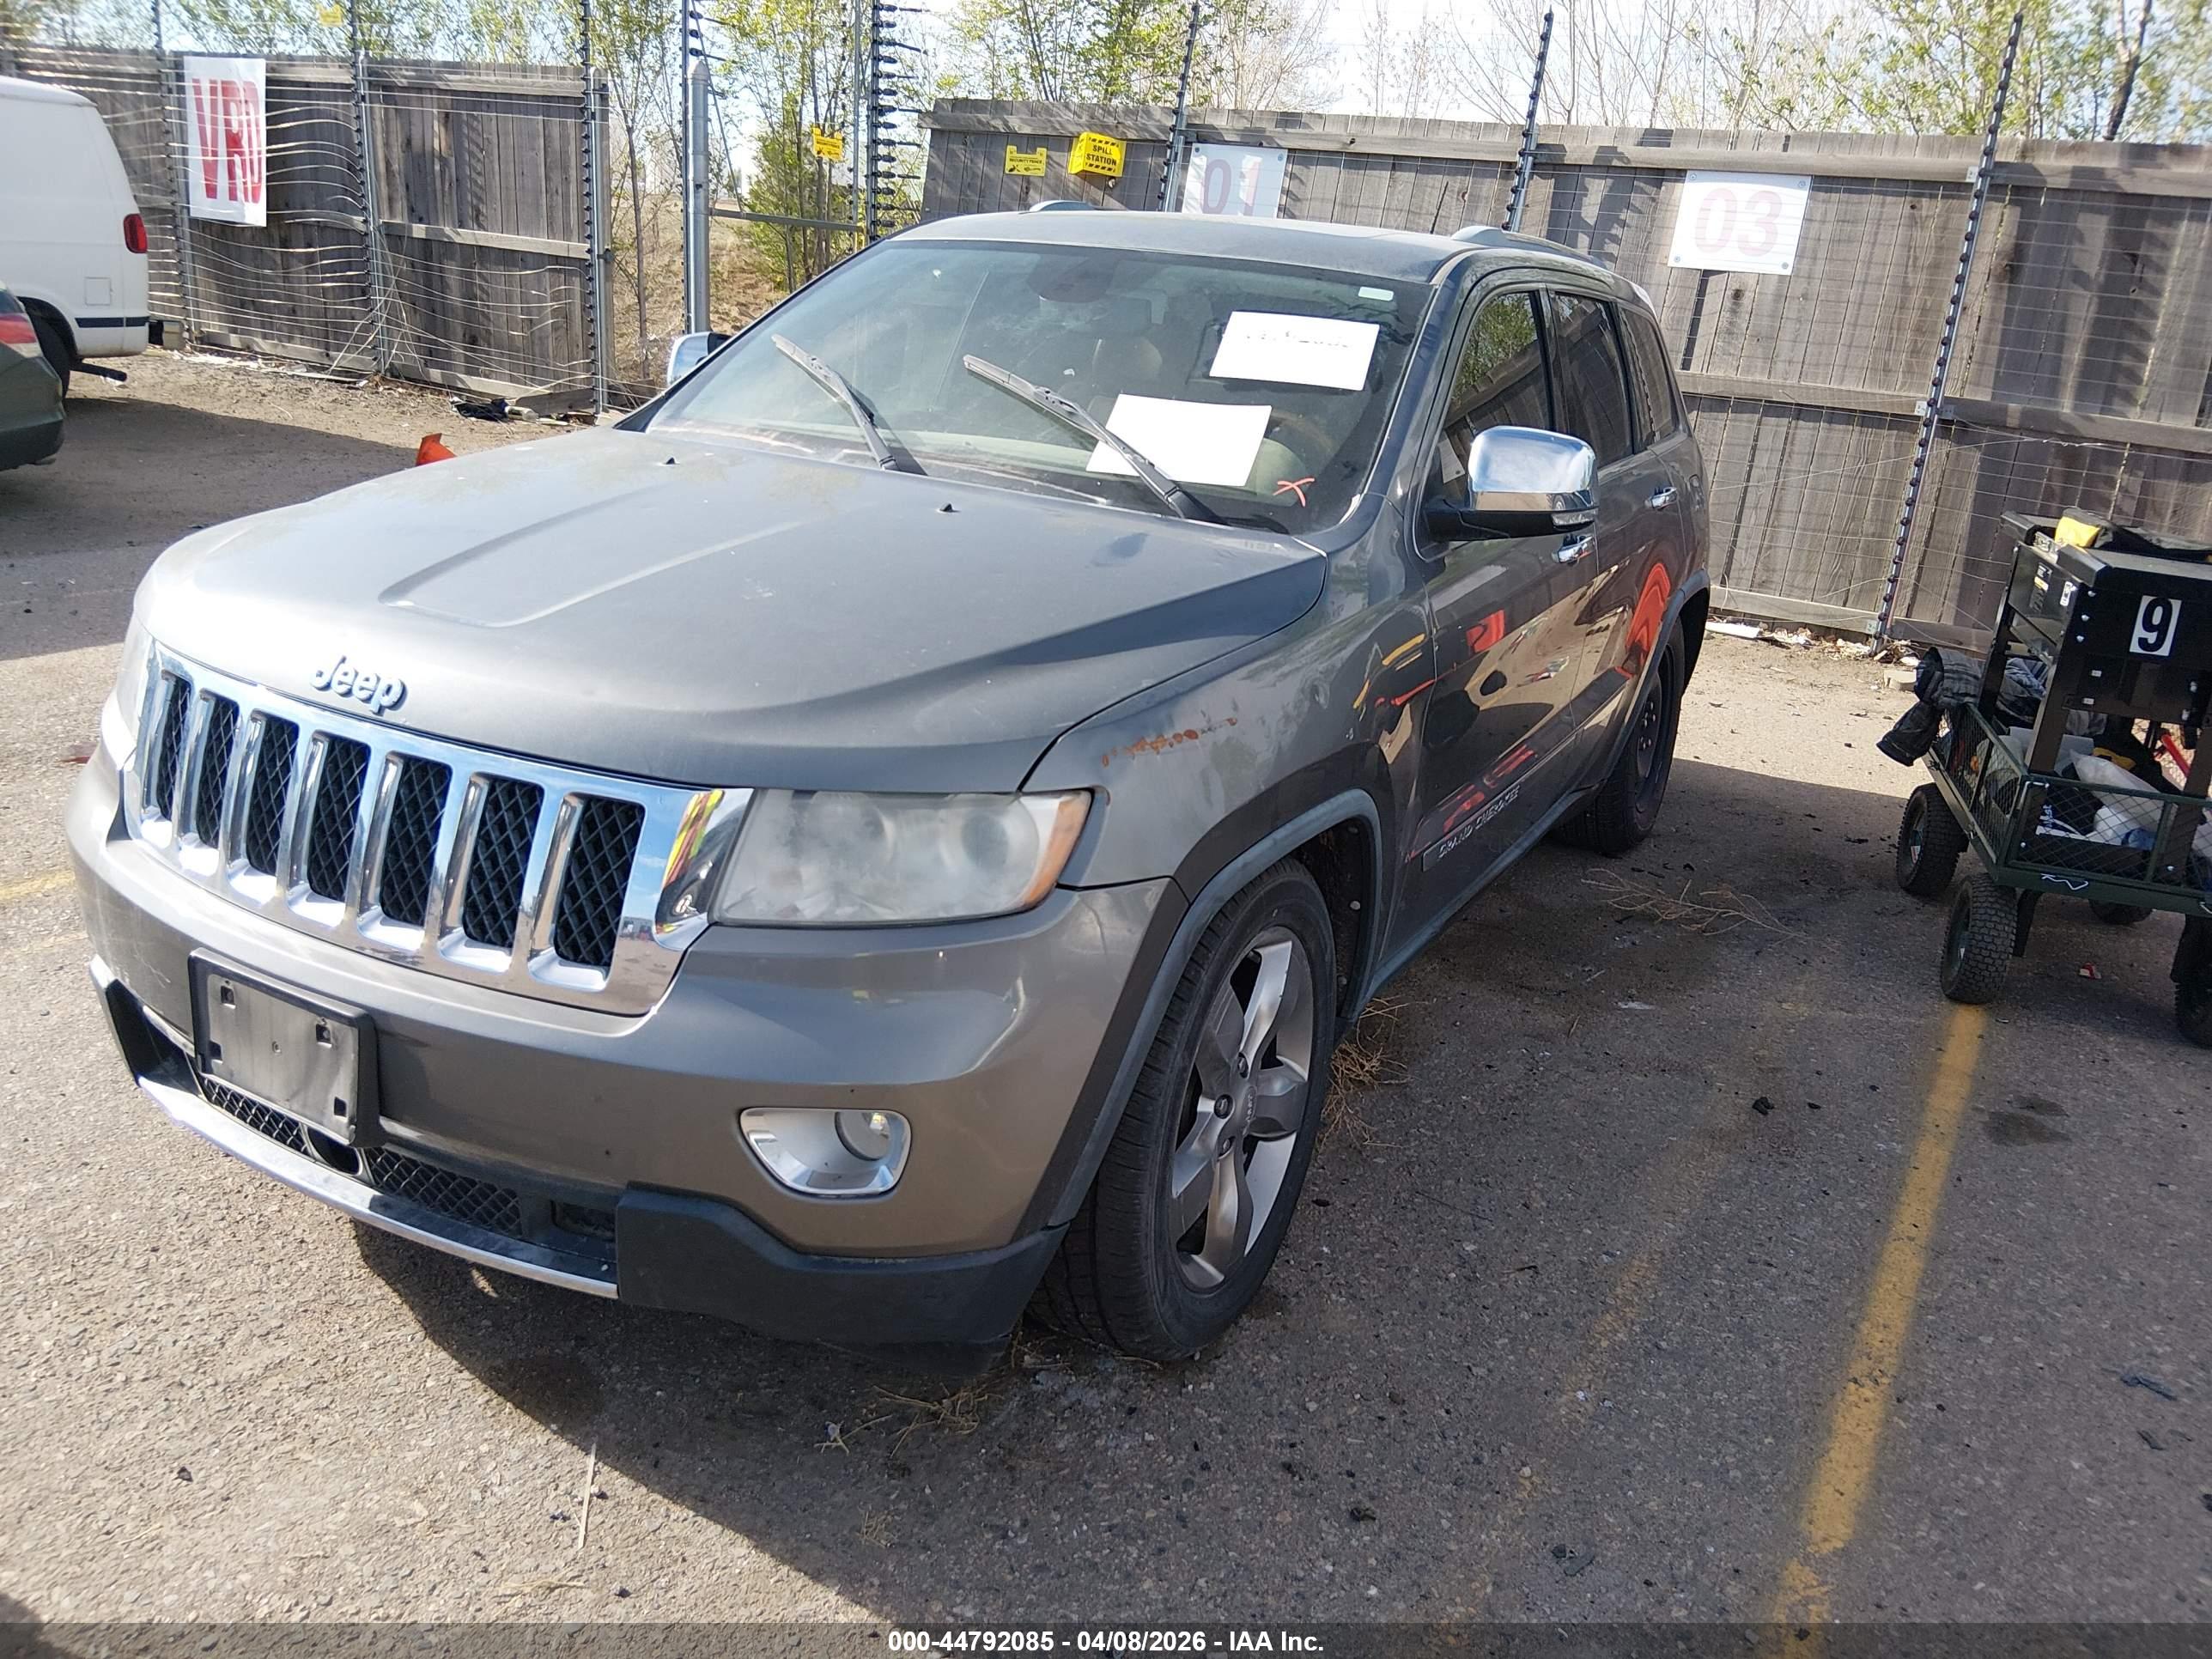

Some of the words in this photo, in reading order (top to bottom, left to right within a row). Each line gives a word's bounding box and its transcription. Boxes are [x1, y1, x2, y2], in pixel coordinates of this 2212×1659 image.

[1085, 153, 1117, 166] STATION
[1092, 145, 1113, 155] SPILL
[1200, 159, 1261, 216] 01
[1694, 187, 1783, 257] 03
[2137, 597, 2173, 653] 9
[309, 654, 408, 717] Jeep
